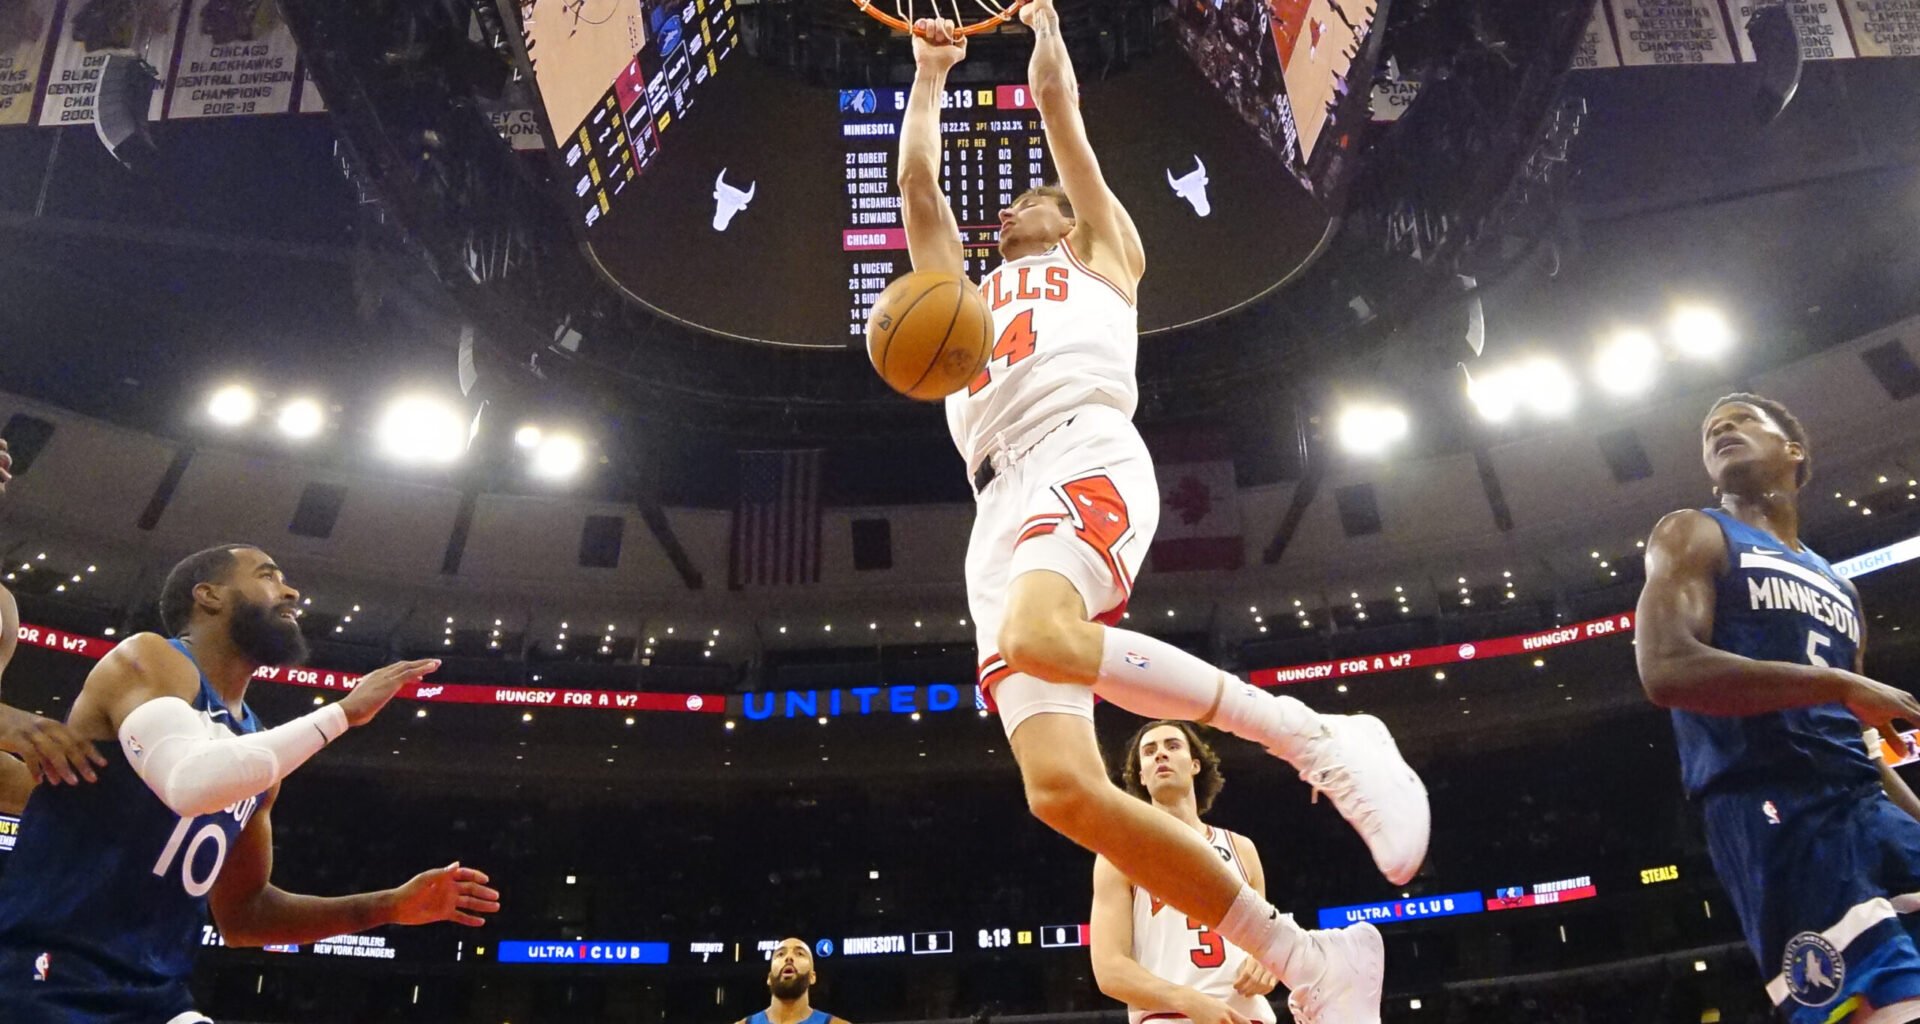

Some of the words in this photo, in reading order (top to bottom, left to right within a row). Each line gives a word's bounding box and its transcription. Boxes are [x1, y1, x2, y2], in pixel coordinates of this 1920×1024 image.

[1638, 18, 1703, 29] WESTERN
[1630, 29, 1717, 41] CONFERENCE
[210, 45, 268, 58] CHICAGO
[1638, 41, 1713, 53] CHAMPIONS
[190, 57, 283, 72] BLACKHAWKS
[175, 75, 235, 88] CENTRAL
[238, 71, 292, 85] DIVISION
[191, 86, 271, 101] CHAMPIONS
[894, 91, 905, 110] 5
[940, 89, 973, 109] 8:13
[1014, 88, 1025, 107] 0
[203, 101, 256, 114] 2012-13
[843, 123, 895, 136] MINNESOTA
[991, 121, 1001, 132] 1/3
[1002, 121, 1023, 131] 33.3%
[957, 139, 970, 148] PTS
[974, 138, 986, 147] REB
[1029, 136, 1041, 145] 3PT
[846, 153, 856, 164] 27
[858, 152, 888, 164] GOBERT
[944, 150, 950, 161] 0
[960, 149, 967, 161] 0
[977, 149, 983, 161] 2
[998, 148, 1012, 160] 0/3
[1029, 148, 1042, 160] 0/0
[846, 168, 857, 180] 30
[858, 167, 888, 179] RANDLE
[945, 165, 950, 176] 0
[961, 164, 967, 176] 0
[978, 164, 983, 175] 1
[999, 163, 1012, 175] 0/2
[1029, 163, 1041, 174] 0/1
[848, 184, 857, 194] 10
[858, 182, 888, 194] CONLEY
[945, 180, 951, 191] 0
[961, 179, 967, 191] 0
[978, 179, 984, 190] 0
[999, 178, 1013, 190] 0/0
[852, 198, 857, 209] 3
[859, 197, 902, 209] MCDANIELS
[962, 194, 968, 206] 0
[979, 194, 984, 205] 1
[1000, 193, 1012, 205] 0/1
[852, 213, 857, 224] 5
[860, 212, 896, 224] EDWARDS
[962, 209, 968, 221] 5
[979, 209, 984, 220] 1
[846, 233, 886, 246] CHICAGO
[853, 264, 858, 275] 9
[861, 262, 893, 274] VUCEVIC
[980, 259, 986, 270] 3
[849, 278, 859, 290] 25
[861, 278, 886, 289] SMITH
[980, 266, 1069, 312] LLS
[854, 293, 859, 304] 3
[851, 309, 859, 320] 14
[850, 323, 861, 335] 30
[968, 308, 1038, 398] 4
[1851, 551, 1893, 573] LIGHT
[18, 627, 37, 642] OR
[46, 635, 57, 646] A
[62, 638, 88, 653] W?
[1523, 628, 1579, 651] HUNGRY
[1587, 619, 1615, 636] FOR
[1620, 616, 1631, 628] A
[1806, 630, 1831, 668] 5
[1277, 663, 1333, 682] HUNGRY
[1340, 659, 1368, 674] FOR
[1373, 658, 1384, 669] A
[1390, 653, 1412, 668] W?
[288, 669, 318, 684] FOR
[324, 674, 335, 686] A
[495, 690, 556, 704] HUNGRY
[563, 692, 592, 705] FOR
[599, 694, 608, 706] A
[616, 694, 637, 707] W?
[743, 683, 959, 721] UNITED
[152, 816, 227, 897] 10
[1640, 864, 1678, 885] STEALS
[1532, 875, 1591, 895] TIMBERWOLVES
[1346, 905, 1391, 922] ULTRA
[1405, 897, 1455, 916] CLUB
[359, 935, 386, 947] OILERS
[843, 934, 906, 955] MINNESOTA
[928, 933, 937, 951] 5
[978, 928, 1011, 948] 8:13
[1186, 914, 1226, 969] 3
[313, 943, 332, 954] NEW
[332, 945, 353, 956] YORK
[353, 946, 395, 959] ISLANDERS
[528, 945, 575, 958] ULTRA
[590, 946, 641, 959] CLUB
